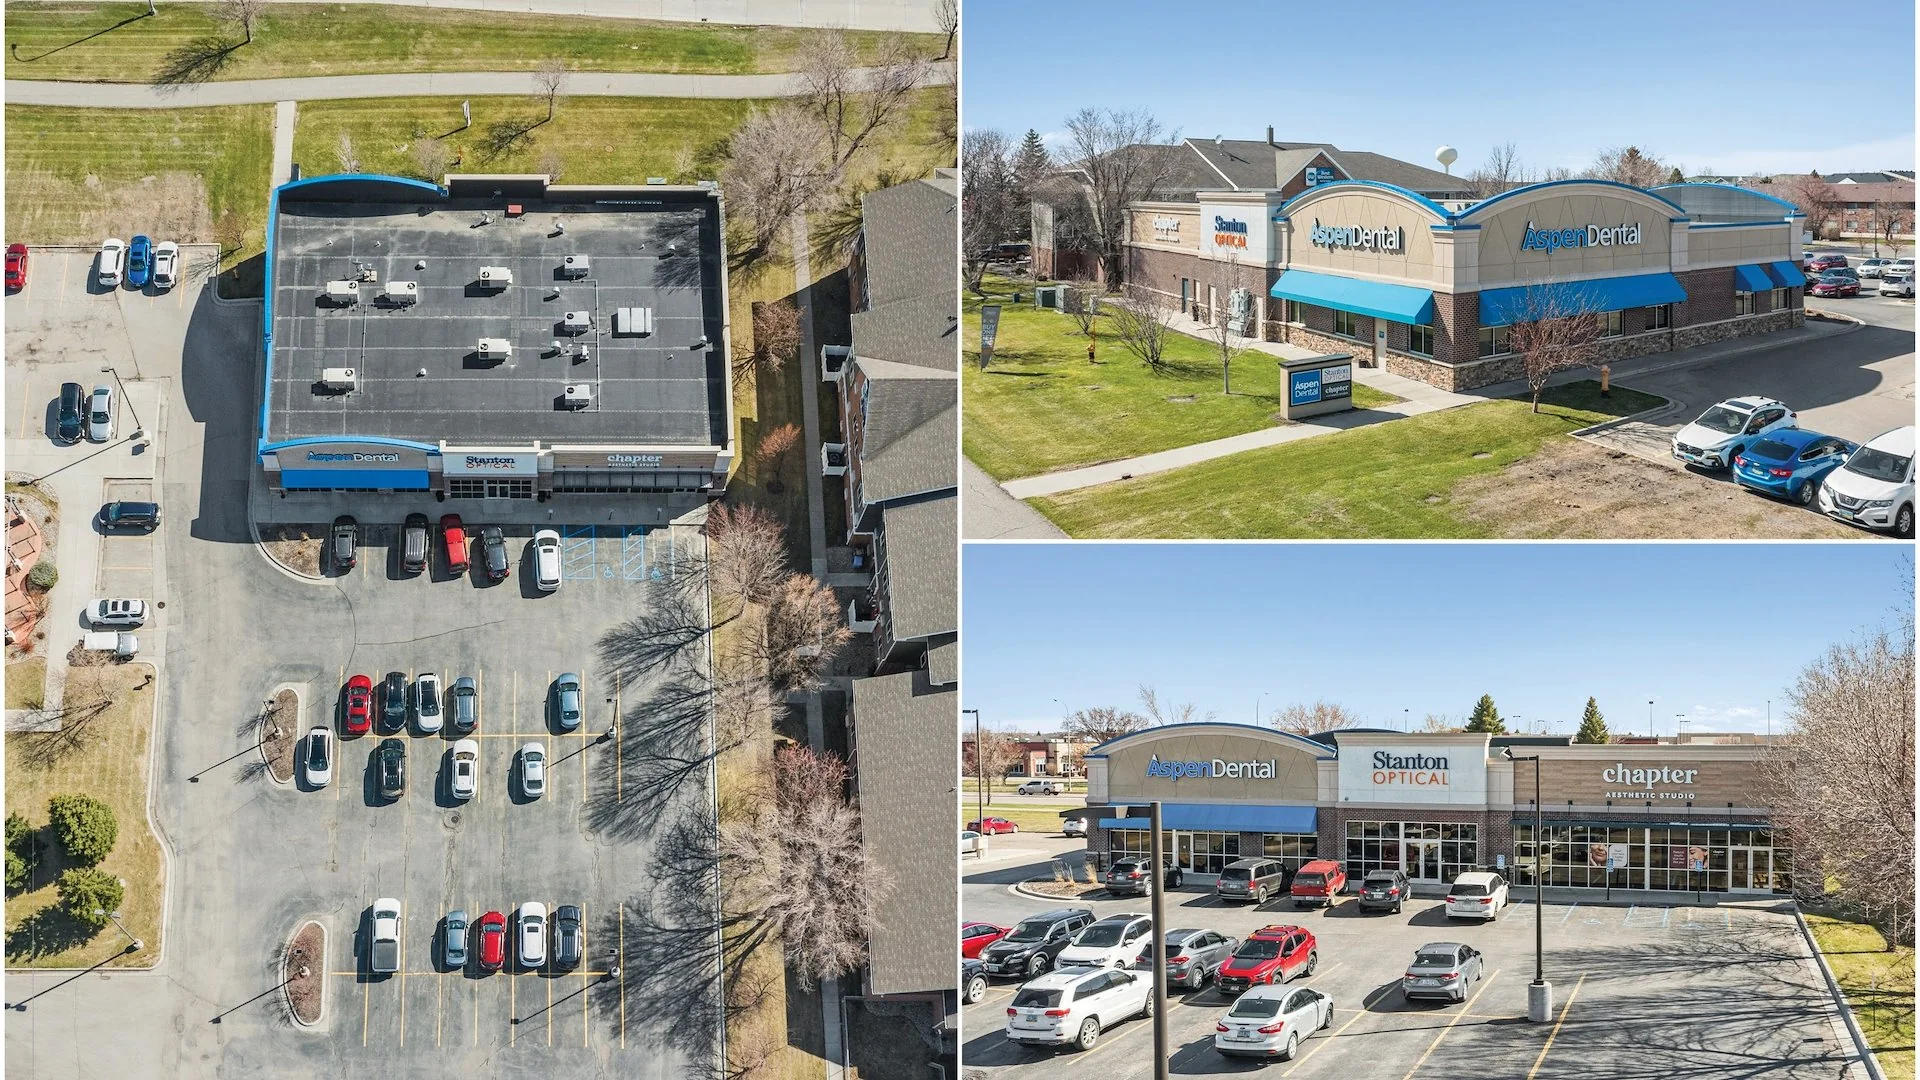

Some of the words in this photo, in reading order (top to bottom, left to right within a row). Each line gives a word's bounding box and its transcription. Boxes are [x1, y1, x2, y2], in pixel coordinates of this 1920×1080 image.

[1215, 215, 1248, 233] Stanton
[1324, 366, 1349, 376] Stanton
[1324, 374, 1349, 382] OPTICAL
[1294, 380, 1319, 391] Aspen
[1325, 384, 1349, 394] chapter
[1295, 387, 1319, 398] Dental
[465, 456, 515, 464] Stanton
[607, 454, 662, 463] chapter
[1373, 751, 1449, 769] Stanton
[1373, 771, 1449, 785] OPTICAL
[1603, 763, 1697, 789] chapter
